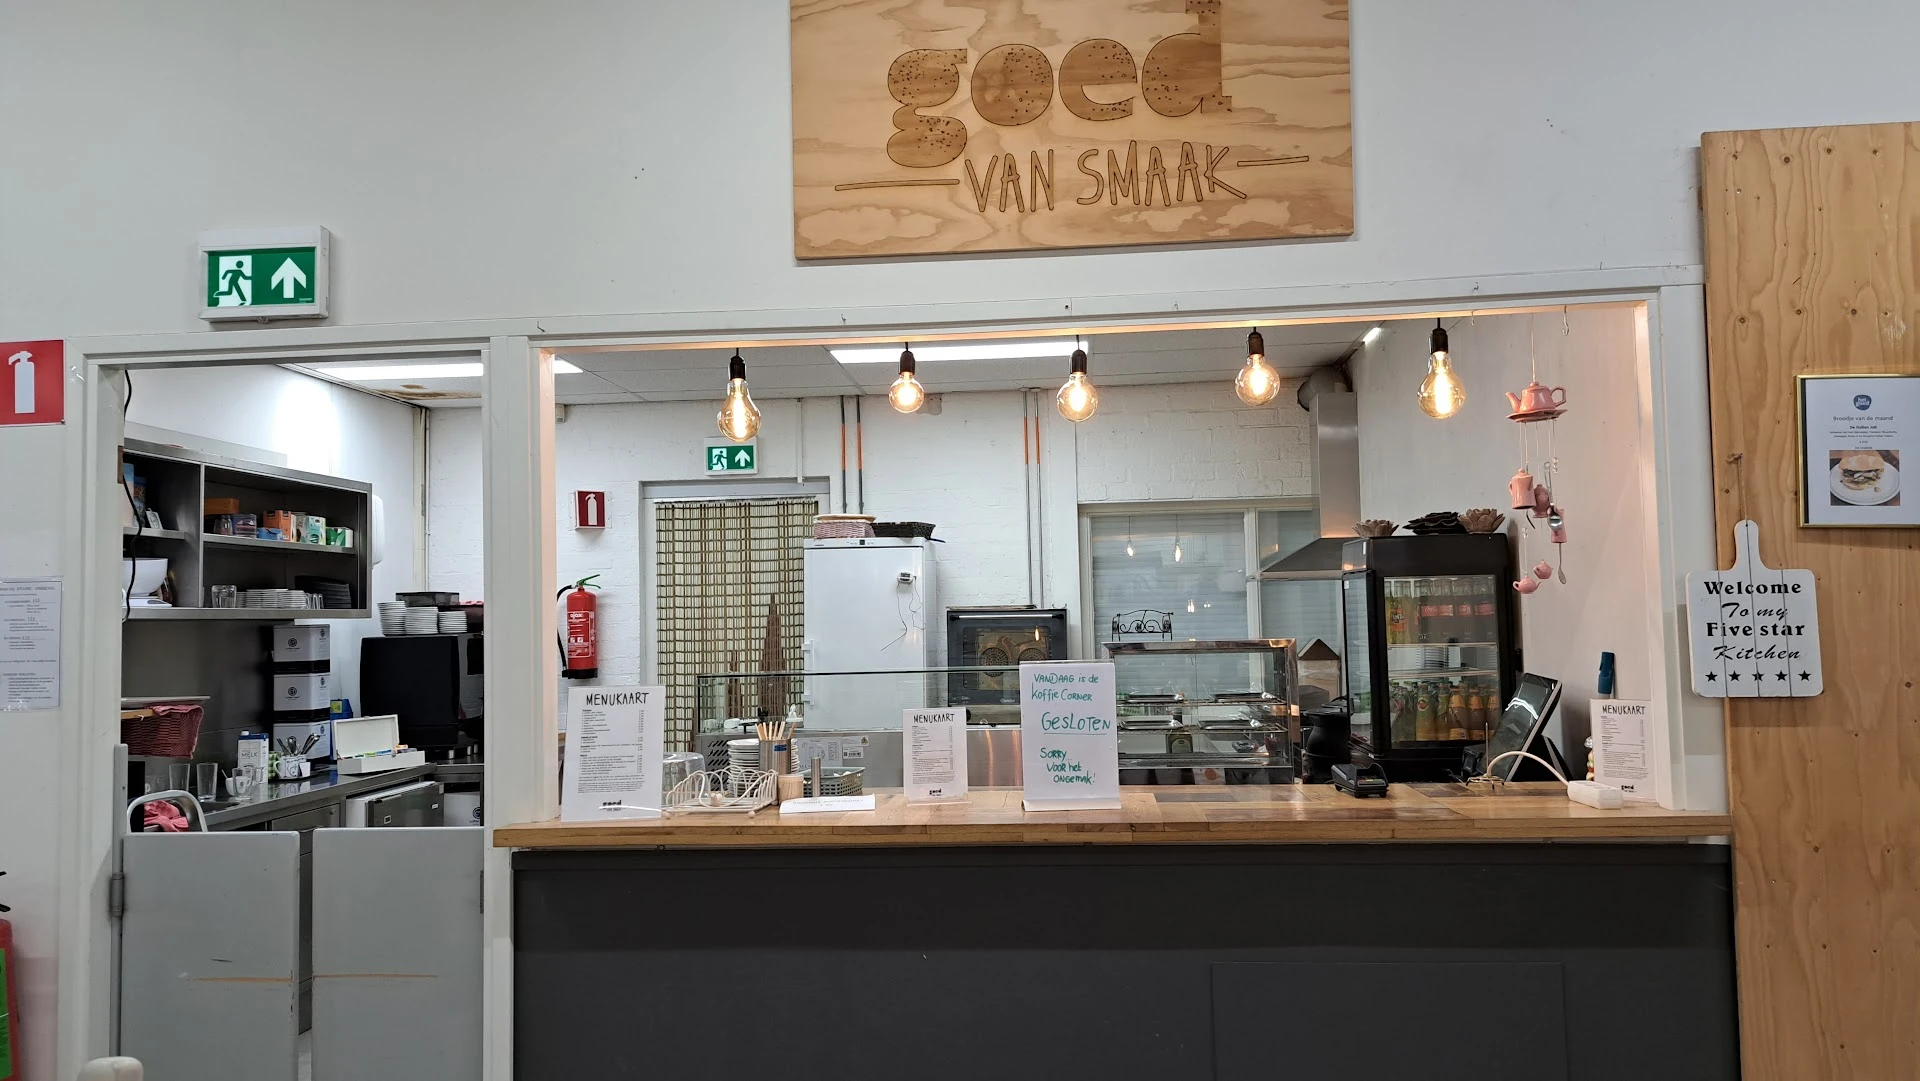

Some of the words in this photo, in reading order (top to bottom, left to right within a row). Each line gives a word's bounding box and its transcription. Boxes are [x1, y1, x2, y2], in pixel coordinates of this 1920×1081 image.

[886, 0, 1232, 168] goed
[965, 148, 1054, 213] VAN
[1076, 140, 1248, 207] SMAAK
[1704, 581, 1801, 595] Welcome
[1721, 602, 1750, 618] To
[1756, 608, 1788, 621] my
[1706, 622, 1753, 637] Five
[1759, 623, 1805, 636] star
[1713, 644, 1801, 660] Kitchen
[1033, 672, 1075, 684] VANDAAG
[1078, 673, 1086, 683] is
[1088, 674, 1099, 684] de
[586, 691, 650, 706] MENUKAART
[1031, 682, 1059, 702] koffie
[1601, 704, 1646, 715] MENUKAART
[913, 712, 955, 724] MENUKAART
[1067, 760, 1082, 772] het
